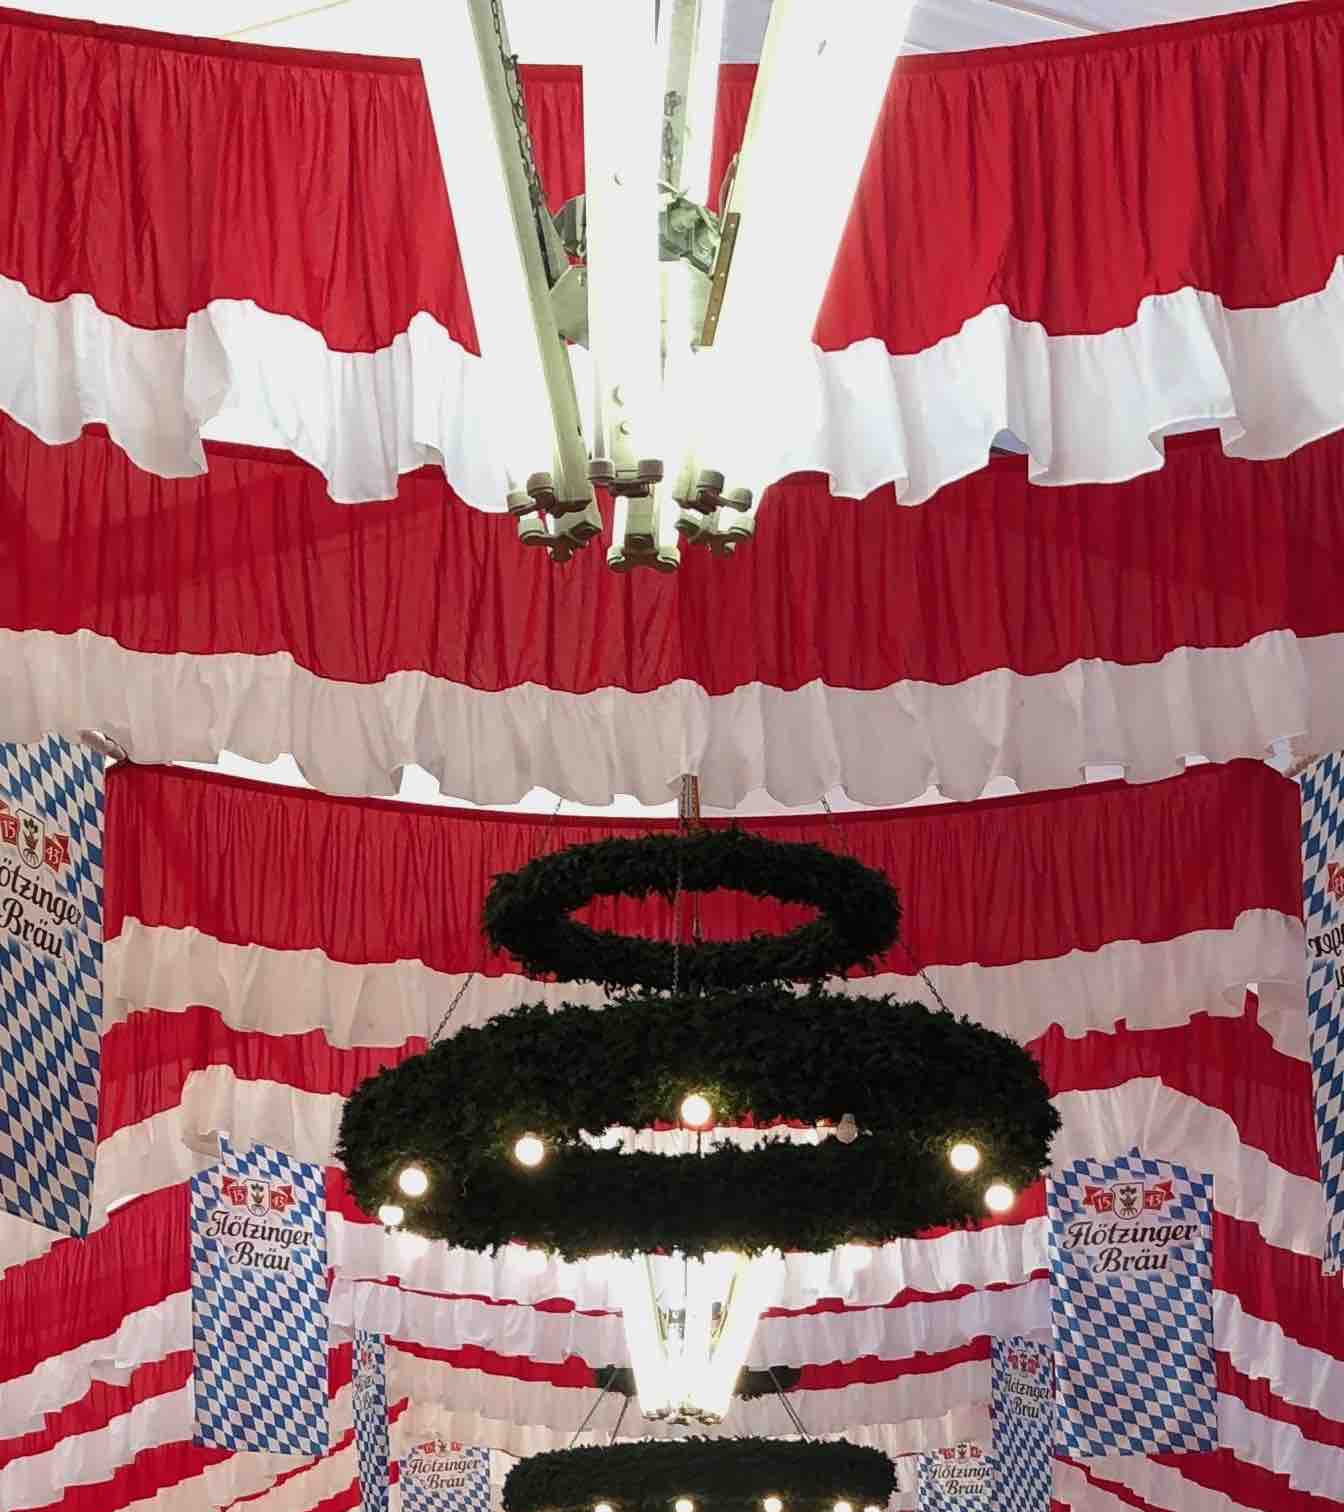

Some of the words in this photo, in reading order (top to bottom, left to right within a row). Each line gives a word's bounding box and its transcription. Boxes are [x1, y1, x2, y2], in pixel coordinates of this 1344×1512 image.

[206, 1210, 313, 1249] Flötzinger
[1063, 1221, 1198, 1250] Flötzinger
[228, 1241, 291, 1271] Bräu
[1093, 1247, 1169, 1273] Bräu
